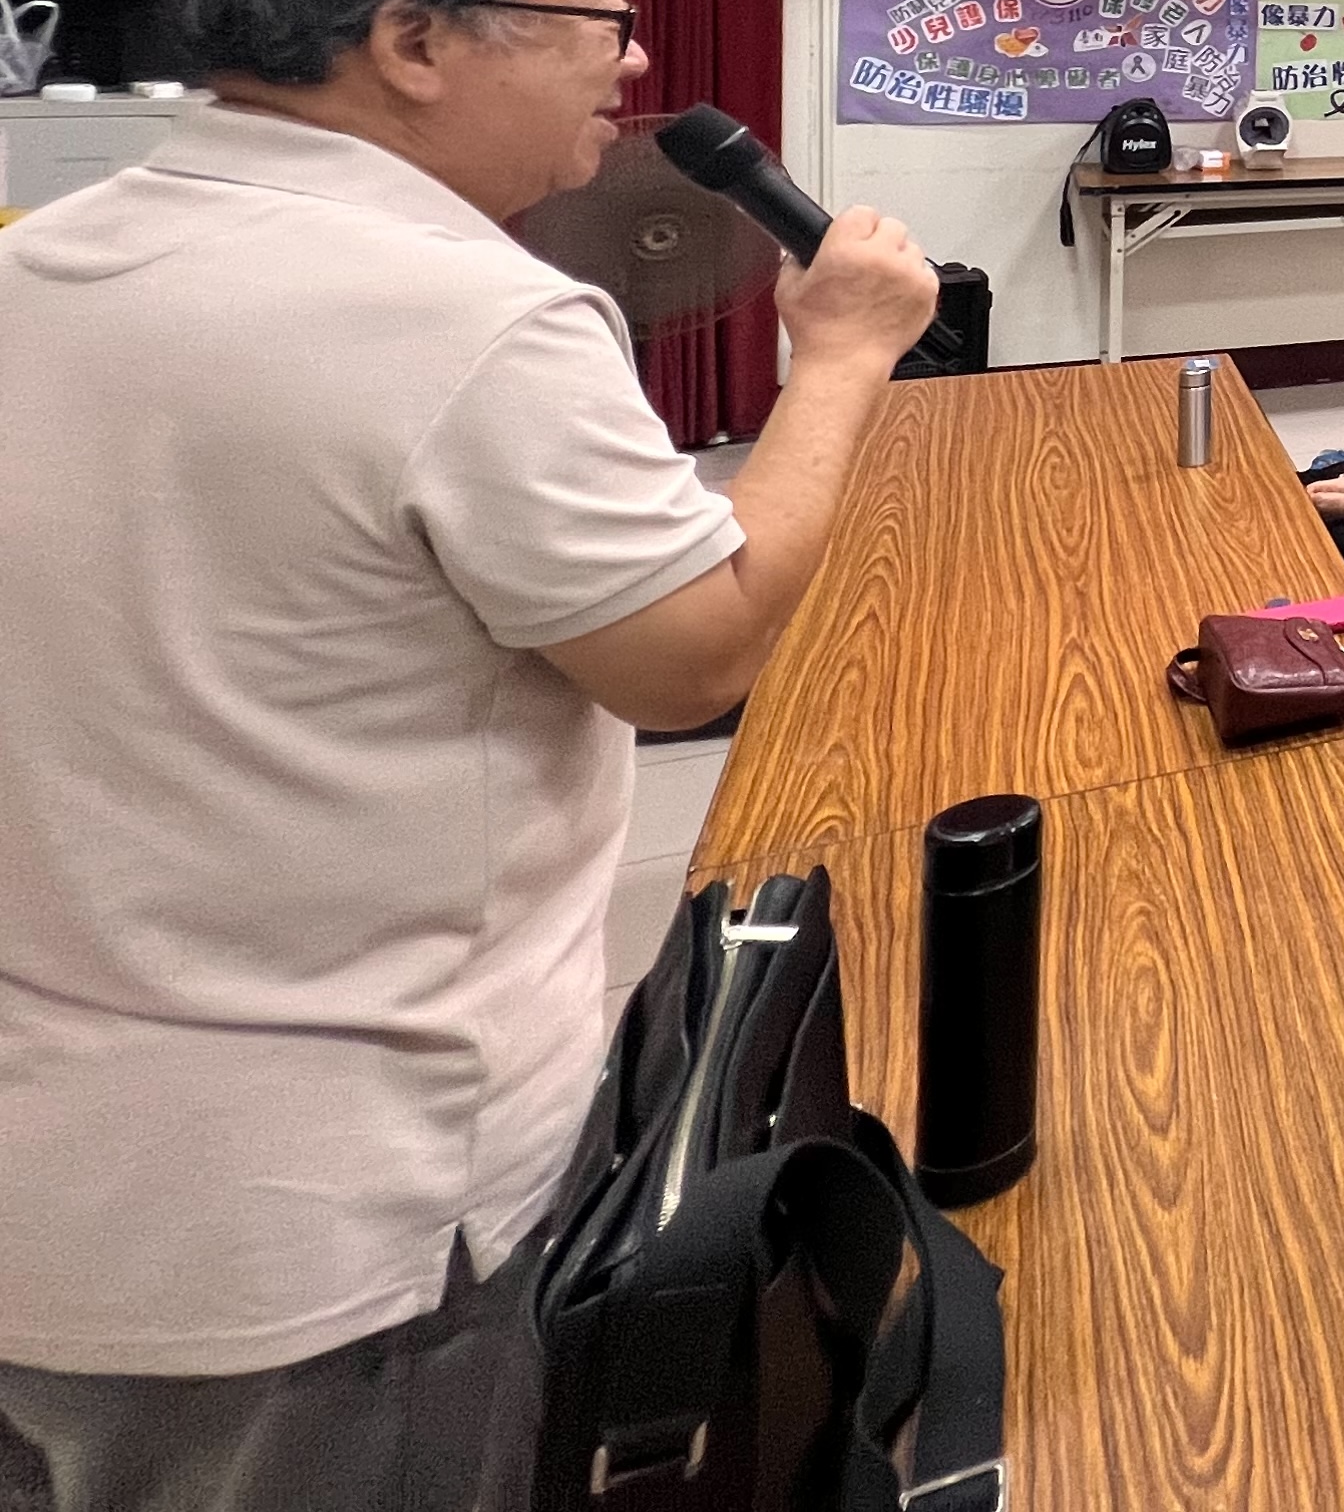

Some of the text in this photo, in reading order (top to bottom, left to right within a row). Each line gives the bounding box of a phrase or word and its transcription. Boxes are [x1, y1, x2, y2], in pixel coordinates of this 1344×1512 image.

[1261, 6, 1335, 27] 像暴力
[856, 59, 1026, 118] 防治性騷擾
